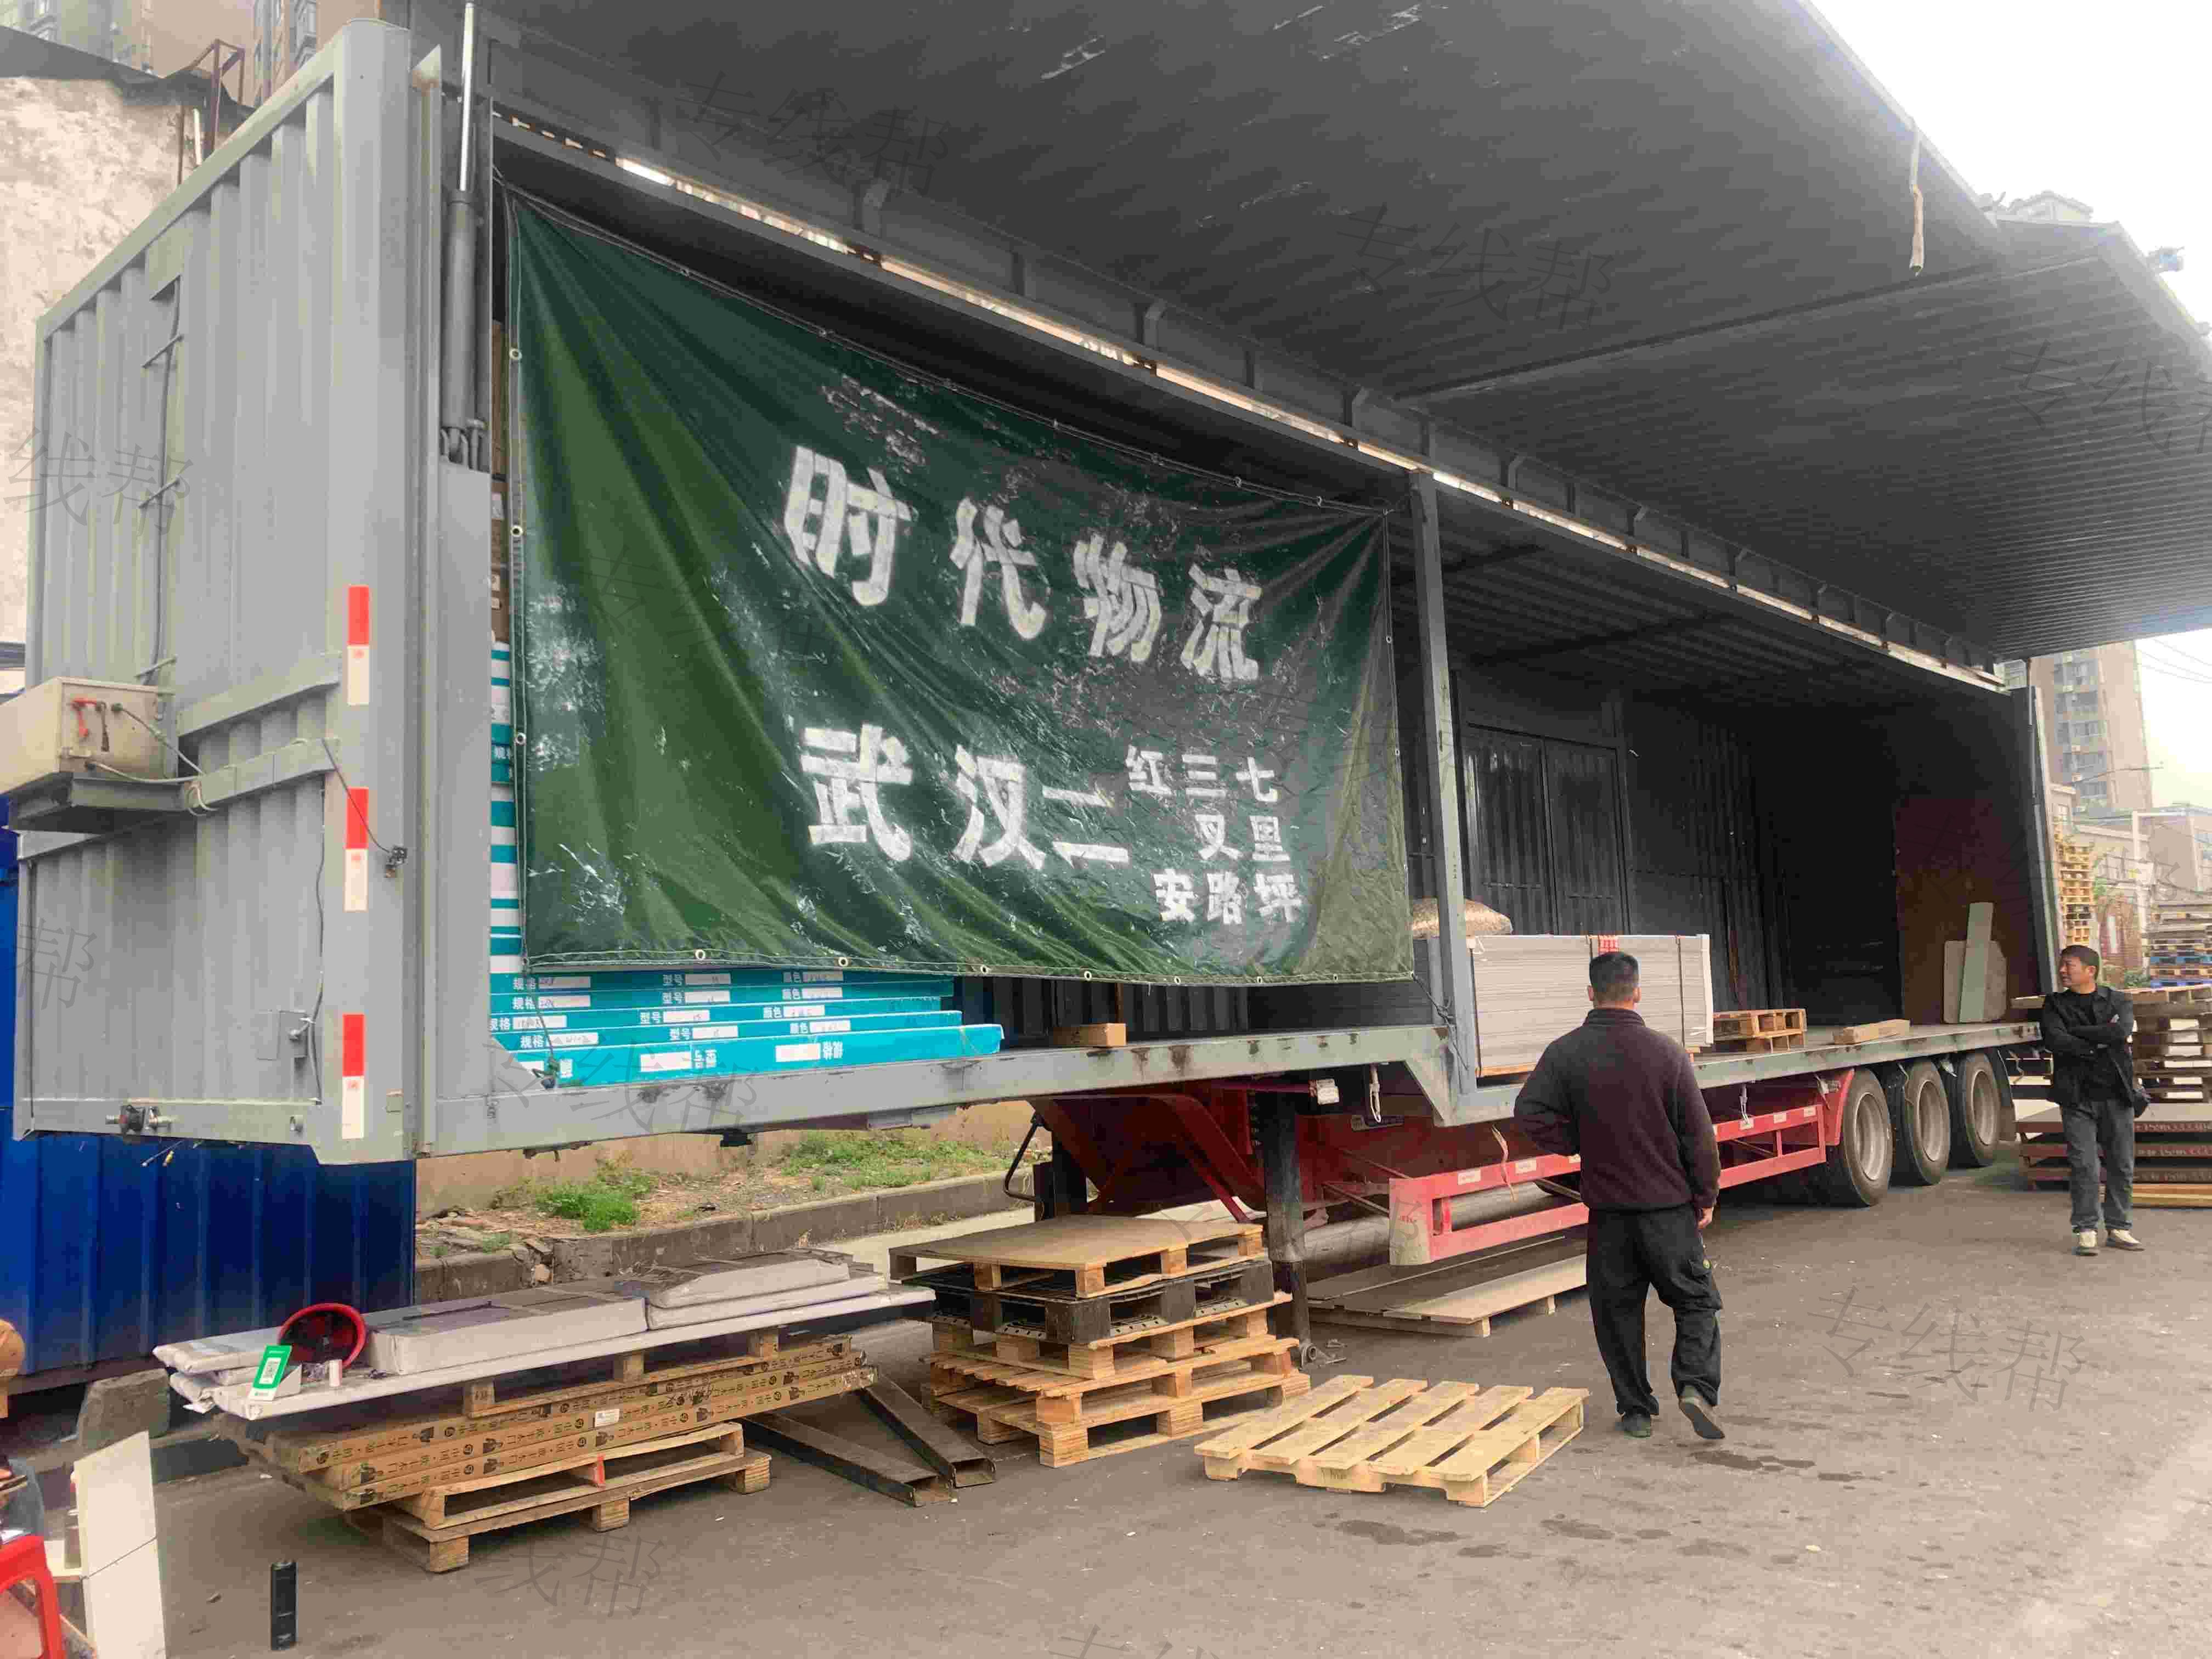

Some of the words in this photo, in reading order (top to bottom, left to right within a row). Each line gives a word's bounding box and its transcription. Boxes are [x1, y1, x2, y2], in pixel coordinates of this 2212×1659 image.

[783, 445, 1262, 681] 时代物流
[662, 992, 683, 1004] 型号
[640, 1012, 662, 1024] 型号
[670, 1027, 691, 1041] 型号
